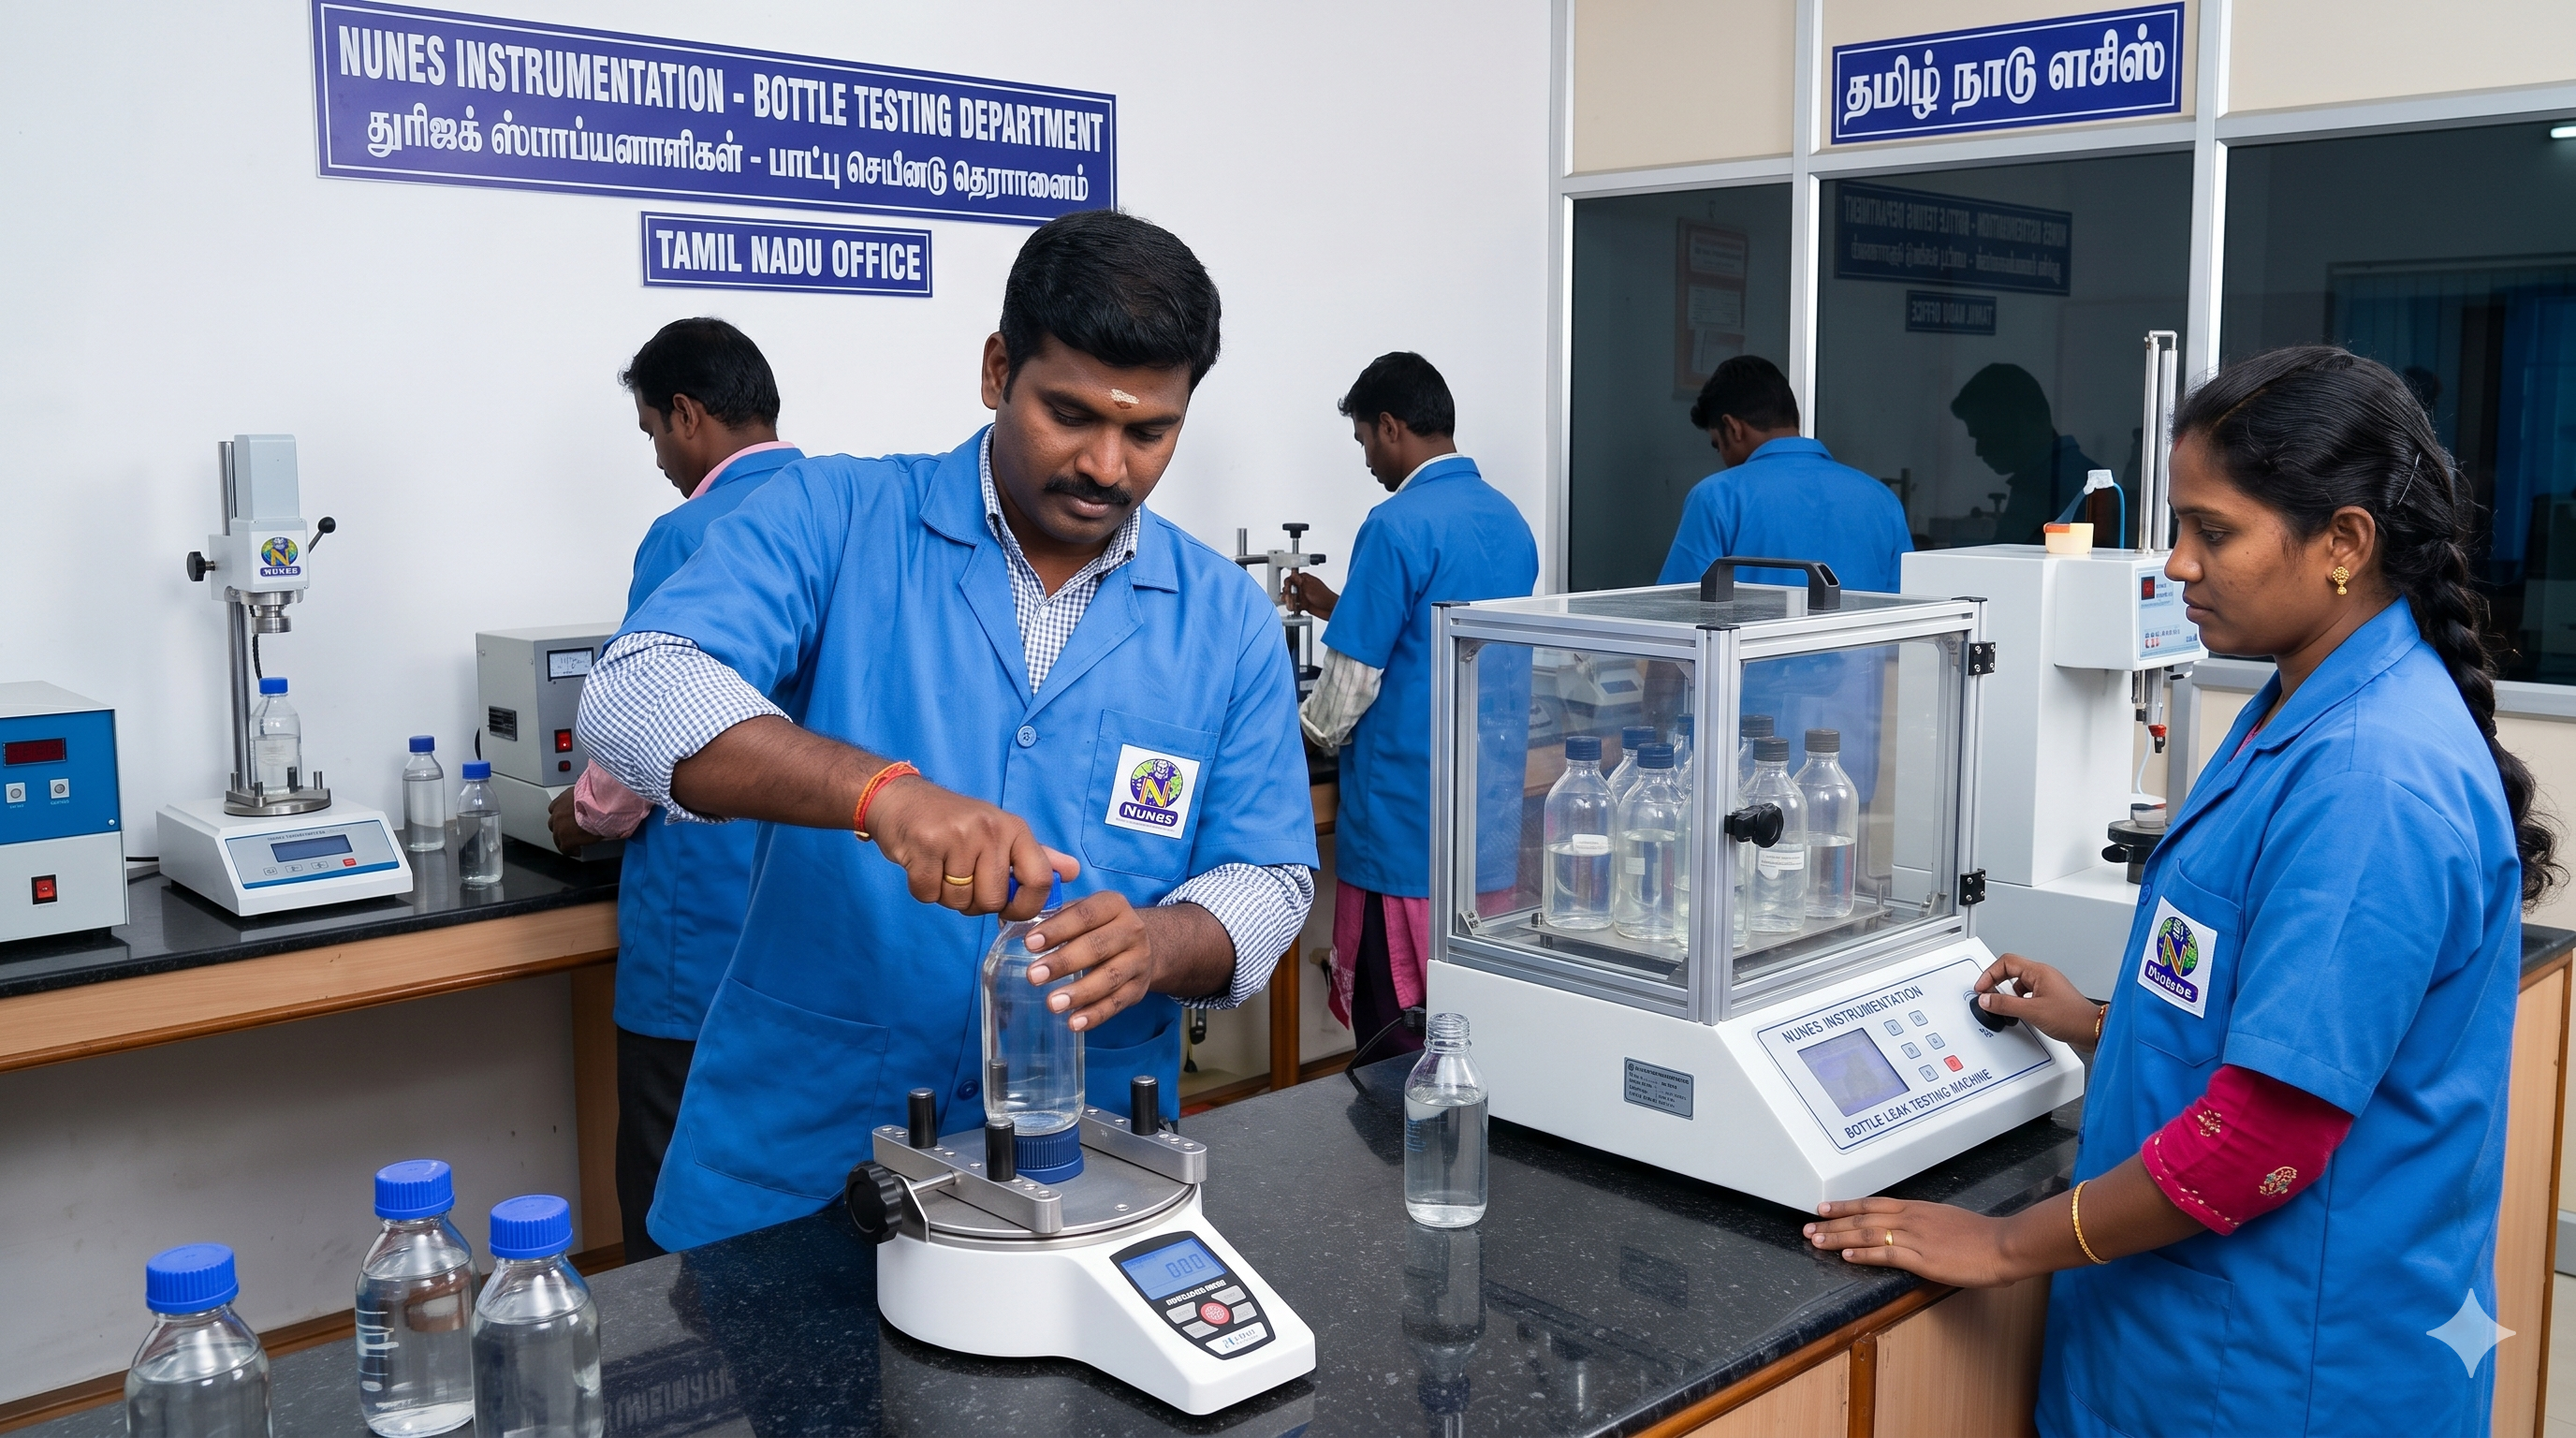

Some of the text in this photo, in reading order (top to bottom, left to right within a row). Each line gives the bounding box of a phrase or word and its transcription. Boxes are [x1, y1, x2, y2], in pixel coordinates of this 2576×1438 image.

[338, 25, 446, 86] NUNES
[456, 38, 724, 113] INSTRUMENTATION
[754, 74, 847, 126] BOTTLE
[854, 84, 952, 138] TESTING
[959, 97, 1104, 153] DEPARTMENT
[1844, 50, 1940, 125] தமிழ்
[1952, 47, 2037, 115] நாடு
[656, 229, 921, 281] TAMIL NADU OFFICE
[1139, 776, 1171, 808] N
[1782, 985, 1924, 1044] NUNES INSTRUMENTATION
[1844, 1068, 1993, 1139] BOTTLE LEAK TESTING MACHINE
